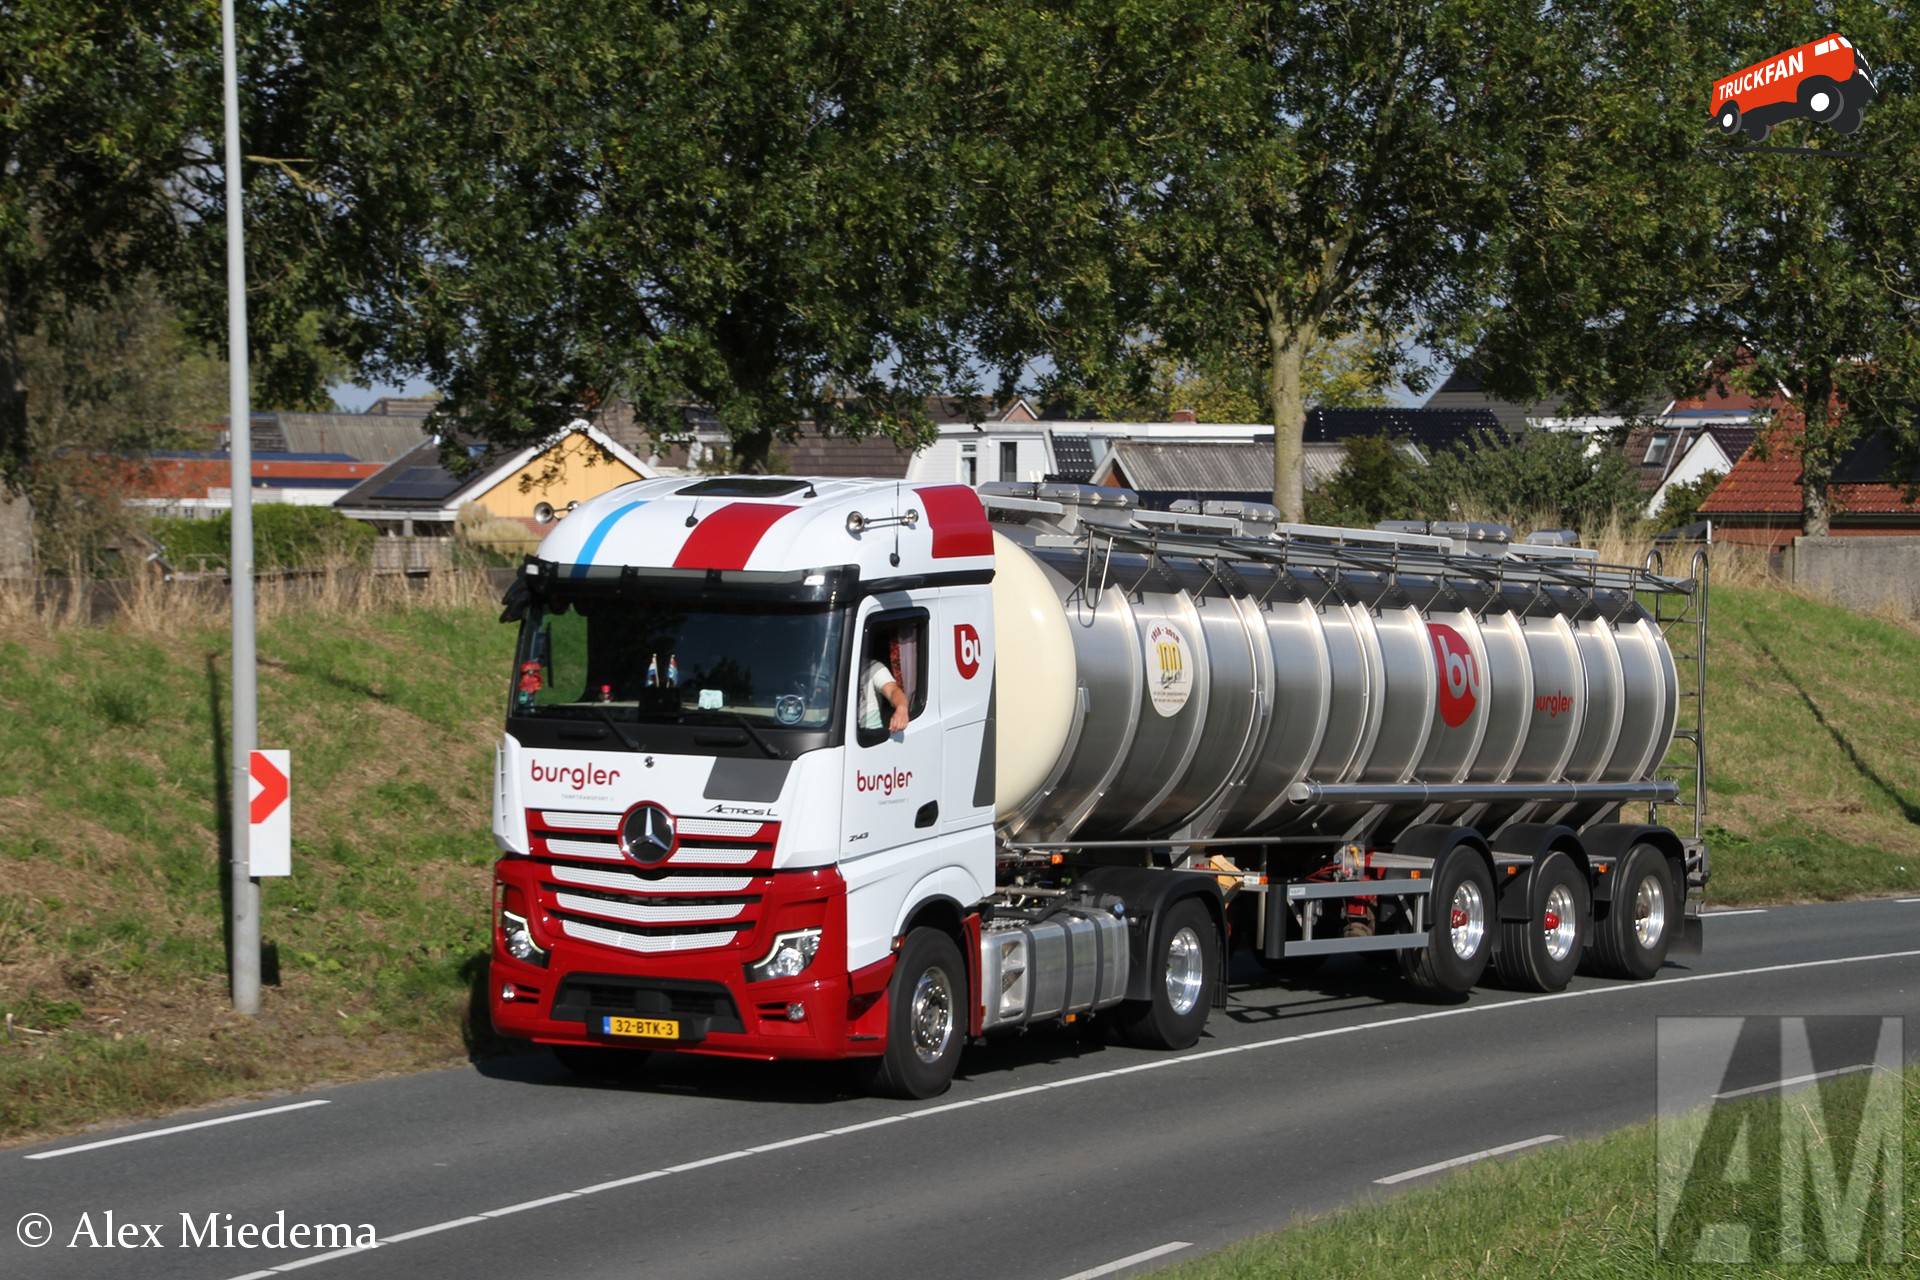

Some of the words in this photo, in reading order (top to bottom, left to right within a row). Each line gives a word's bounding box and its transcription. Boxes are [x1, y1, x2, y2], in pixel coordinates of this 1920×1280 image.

[1536, 689, 1574, 718] urgler
[531, 759, 620, 790] burgler
[856, 766, 913, 796] burgler
[615, 1019, 674, 1036] 32-BTK-3
